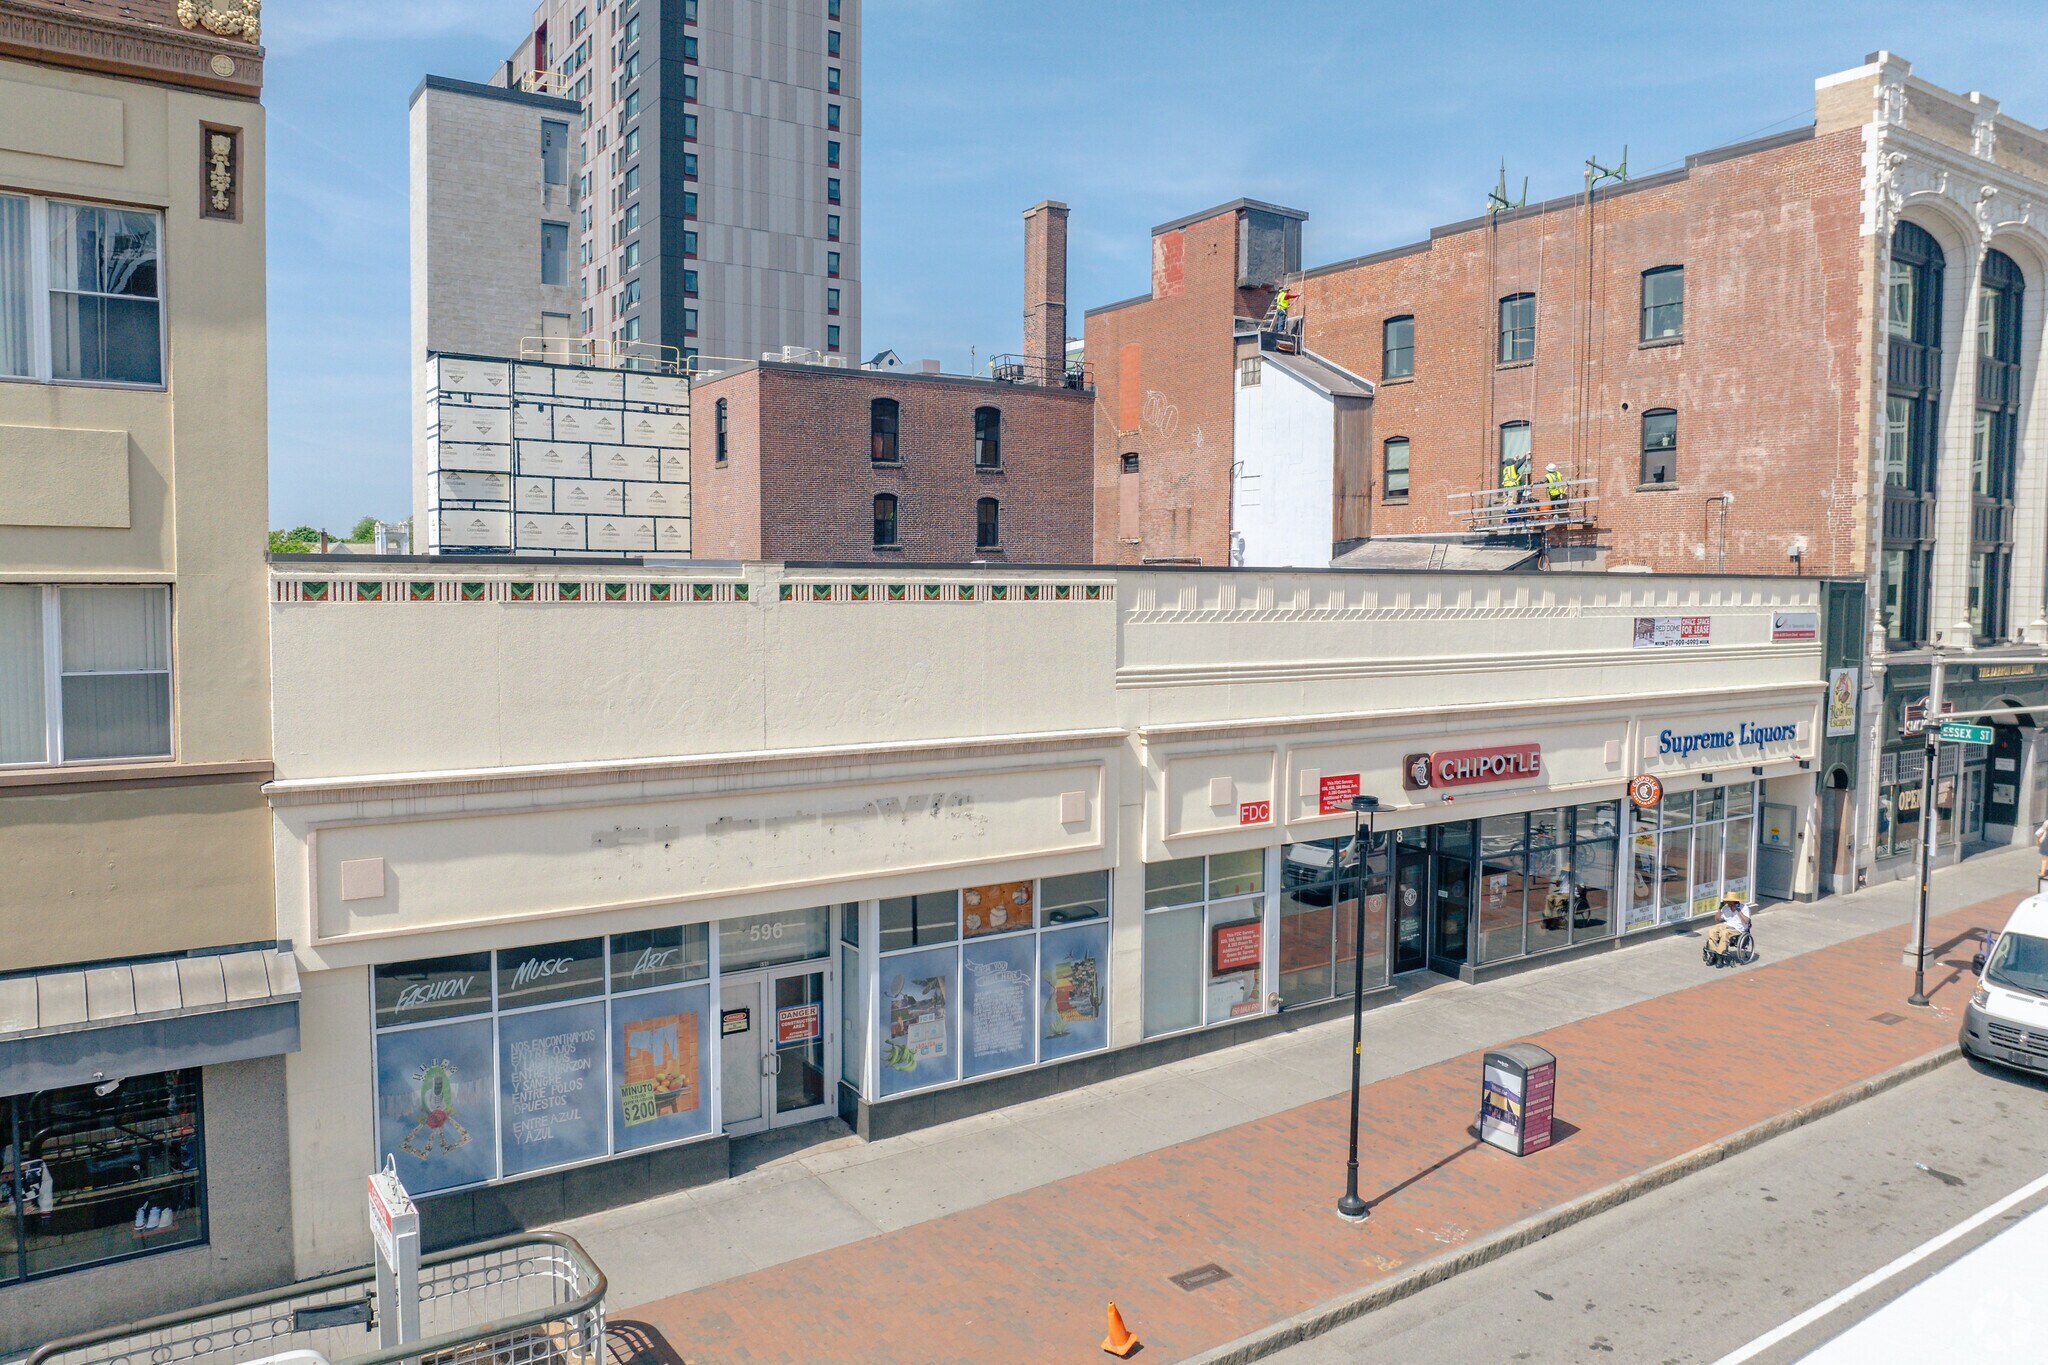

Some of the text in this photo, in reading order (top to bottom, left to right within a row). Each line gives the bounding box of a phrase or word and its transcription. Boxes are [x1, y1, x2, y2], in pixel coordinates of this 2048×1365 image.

[1682, 625, 1710, 634] FOR LEASE
[1660, 722, 1795, 758] Supreme Liquors
[1943, 726, 1990, 740] ESSEX ST
[1440, 751, 1540, 780] CHIPOTLE
[1632, 776, 1658, 790] CHIPOTLE
[1242, 804, 1268, 822] FDC
[750, 923, 782, 941] 596
[631, 947, 678, 979] ART
[511, 957, 573, 990] MUSIC
[395, 976, 474, 1014] FASHION
[781, 1008, 816, 1019] DANGER
[781, 1017, 816, 1027] CONSTRUCTION
[511, 1029, 596, 1054] NOS ENCONTRAMOS
[511, 1043, 576, 1063] ENTRE OJOS
[511, 1068, 545, 1082] ENTRE
[511, 1077, 583, 1104] ENTRE POLOS
[512, 1082, 520, 1092] Y
[622, 1083, 653, 1097] MINUTO
[513, 1095, 567, 1115] OPUESTOS
[513, 1108, 581, 1133] ENTRE AZUL
[515, 1126, 554, 1144] Y AZUL
